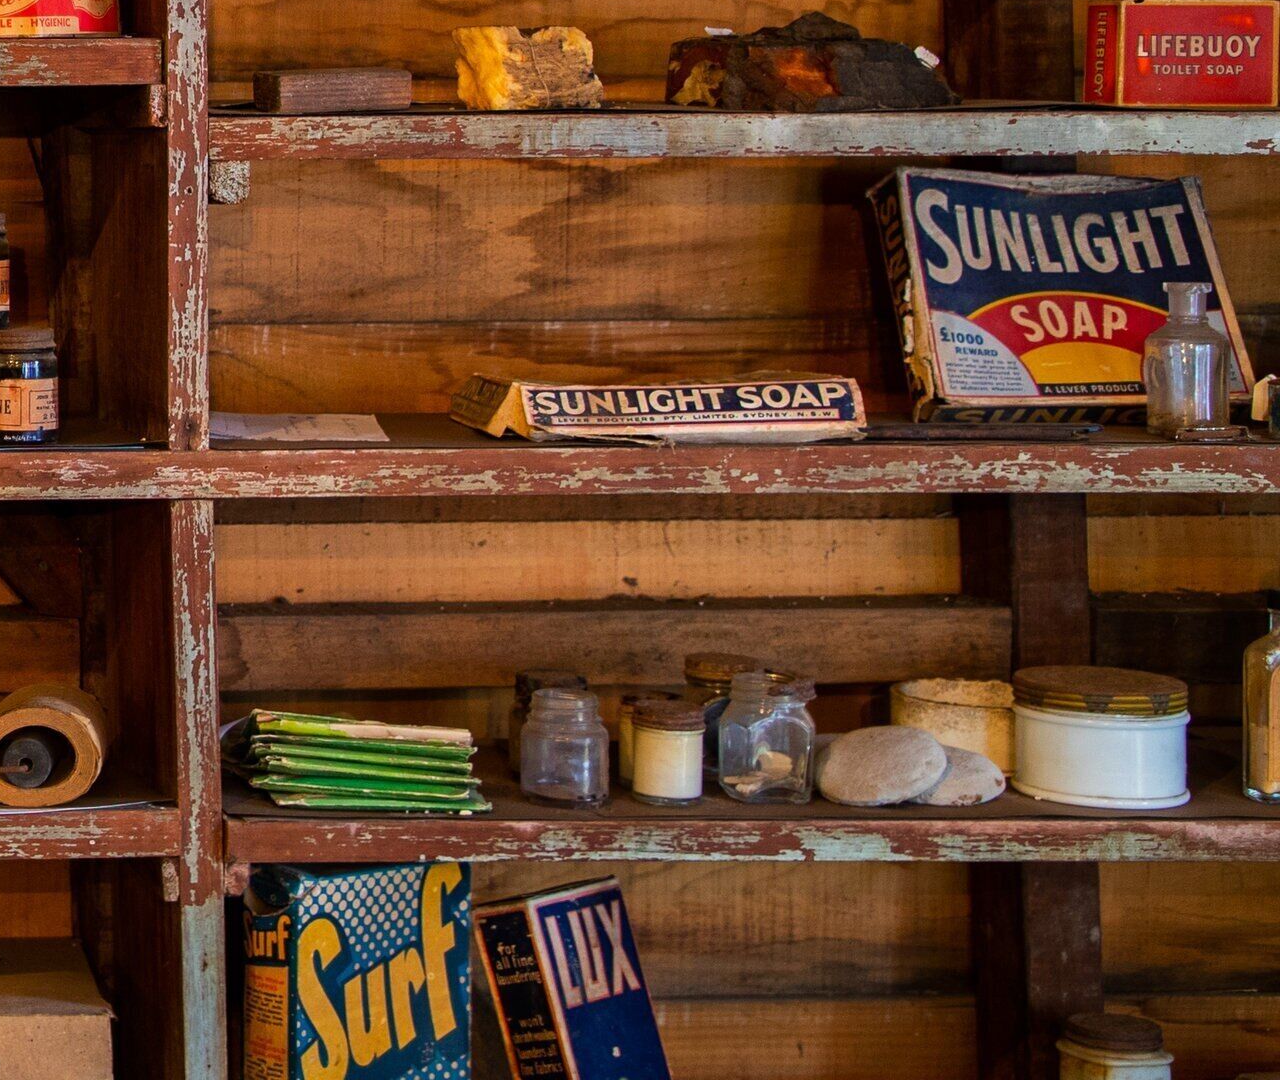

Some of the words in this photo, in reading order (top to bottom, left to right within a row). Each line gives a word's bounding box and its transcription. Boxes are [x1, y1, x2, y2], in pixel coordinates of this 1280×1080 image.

[30, 17, 71, 28] HYGIENIC
[1093, 11, 1108, 97] LIFEBUOY
[1137, 35, 1261, 58] LIFEBUOY
[1153, 64, 1200, 75] TOILET
[1207, 64, 1244, 75] SOAP
[914, 188, 1191, 285] SUNLIGHT
[1010, 299, 1128, 343] SOAP
[940, 326, 984, 345] £1000
[955, 346, 998, 357] REWARD
[536, 387, 725, 415] SUNLIGHT
[737, 383, 848, 408] SOAP
[1043, 385, 1053, 394] A
[1054, 384, 1088, 394] LEVER
[1090, 383, 1140, 394] PRODUCT
[243, 911, 292, 960] Surf
[496, 941, 516, 956] for
[544, 898, 641, 1010] LUX
[297, 863, 464, 1080] Surf
[496, 957, 511, 970] all
[512, 955, 536, 969] fine
